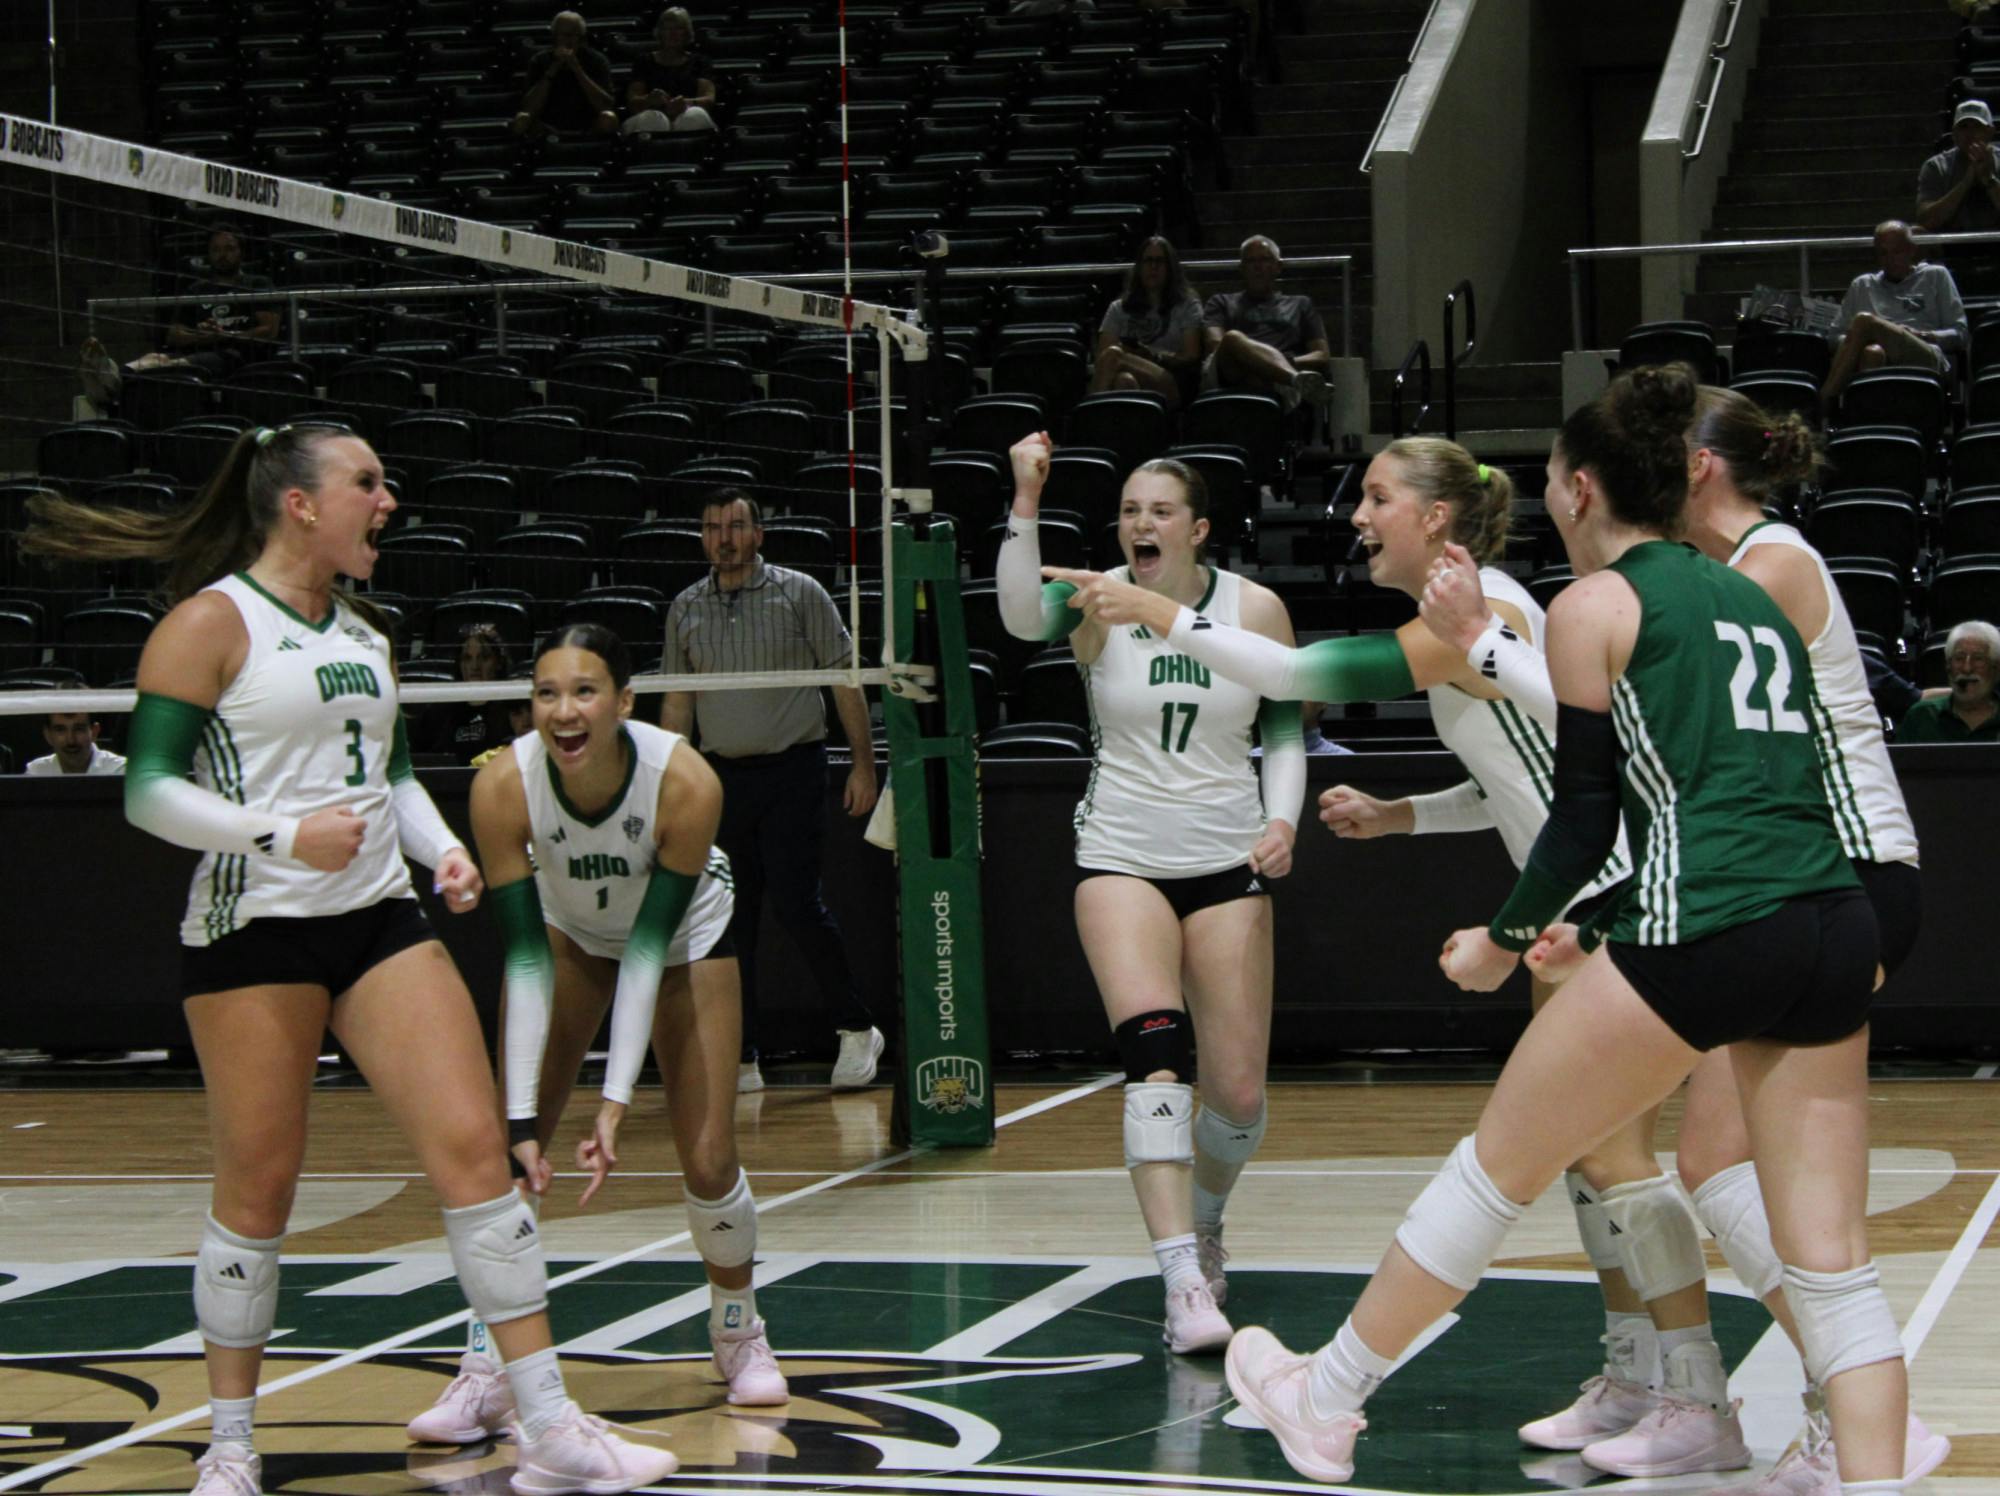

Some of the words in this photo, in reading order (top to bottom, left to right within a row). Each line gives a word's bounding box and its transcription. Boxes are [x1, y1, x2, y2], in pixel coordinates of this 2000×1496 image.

[11, 120, 64, 162] BOBCATS
[315, 662, 381, 702] OHIO
[1149, 653, 1211, 689] OHIO
[1713, 620, 1809, 734] 22
[344, 718, 366, 787] 3
[1161, 701, 1199, 753] 17
[595, 886, 608, 911] 1
[931, 890, 954, 956] sports
[934, 960, 957, 1041] imports
